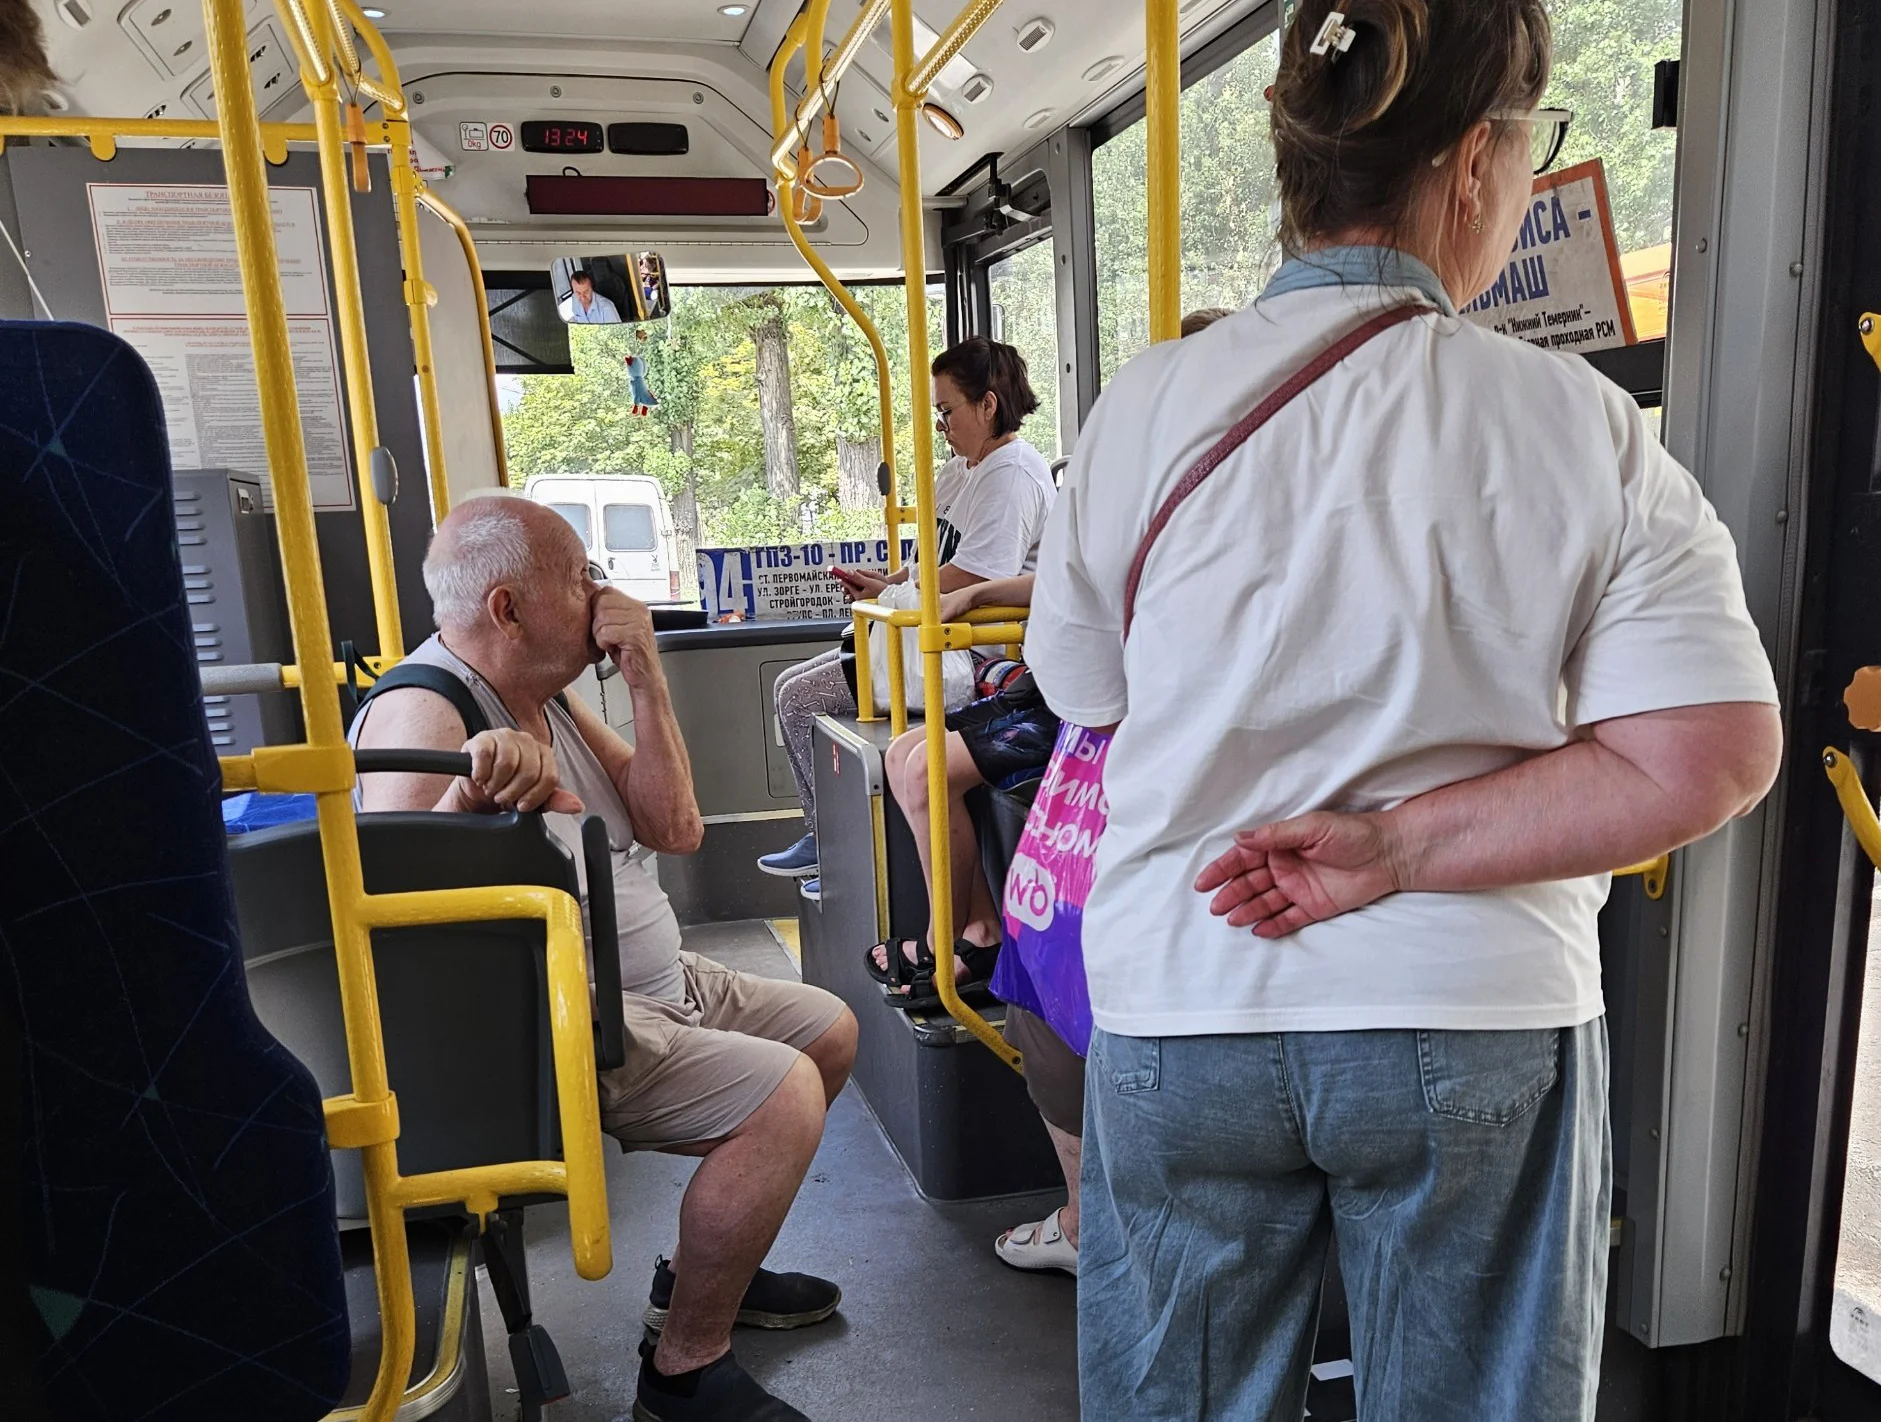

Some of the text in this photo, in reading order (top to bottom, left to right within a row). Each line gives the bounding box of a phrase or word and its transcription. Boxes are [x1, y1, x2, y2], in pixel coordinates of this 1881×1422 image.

[493, 130, 509, 144] 70
[1511, 195, 1571, 252] ИСА
[1551, 327, 1594, 349] проходная
[1595, 319, 1616, 339] РСМ
[756, 543, 823, 568] ГПЗ-10
[840, 541, 872, 564] ПР.
[775, 585, 799, 597] ЗОРГЕ
[809, 584, 823, 594] УЛ.
[770, 595, 833, 609] СТРОЙГОРОДОК
[822, 609, 836, 619] ПЛ.
[839, 608, 852, 618] ЛЕ
